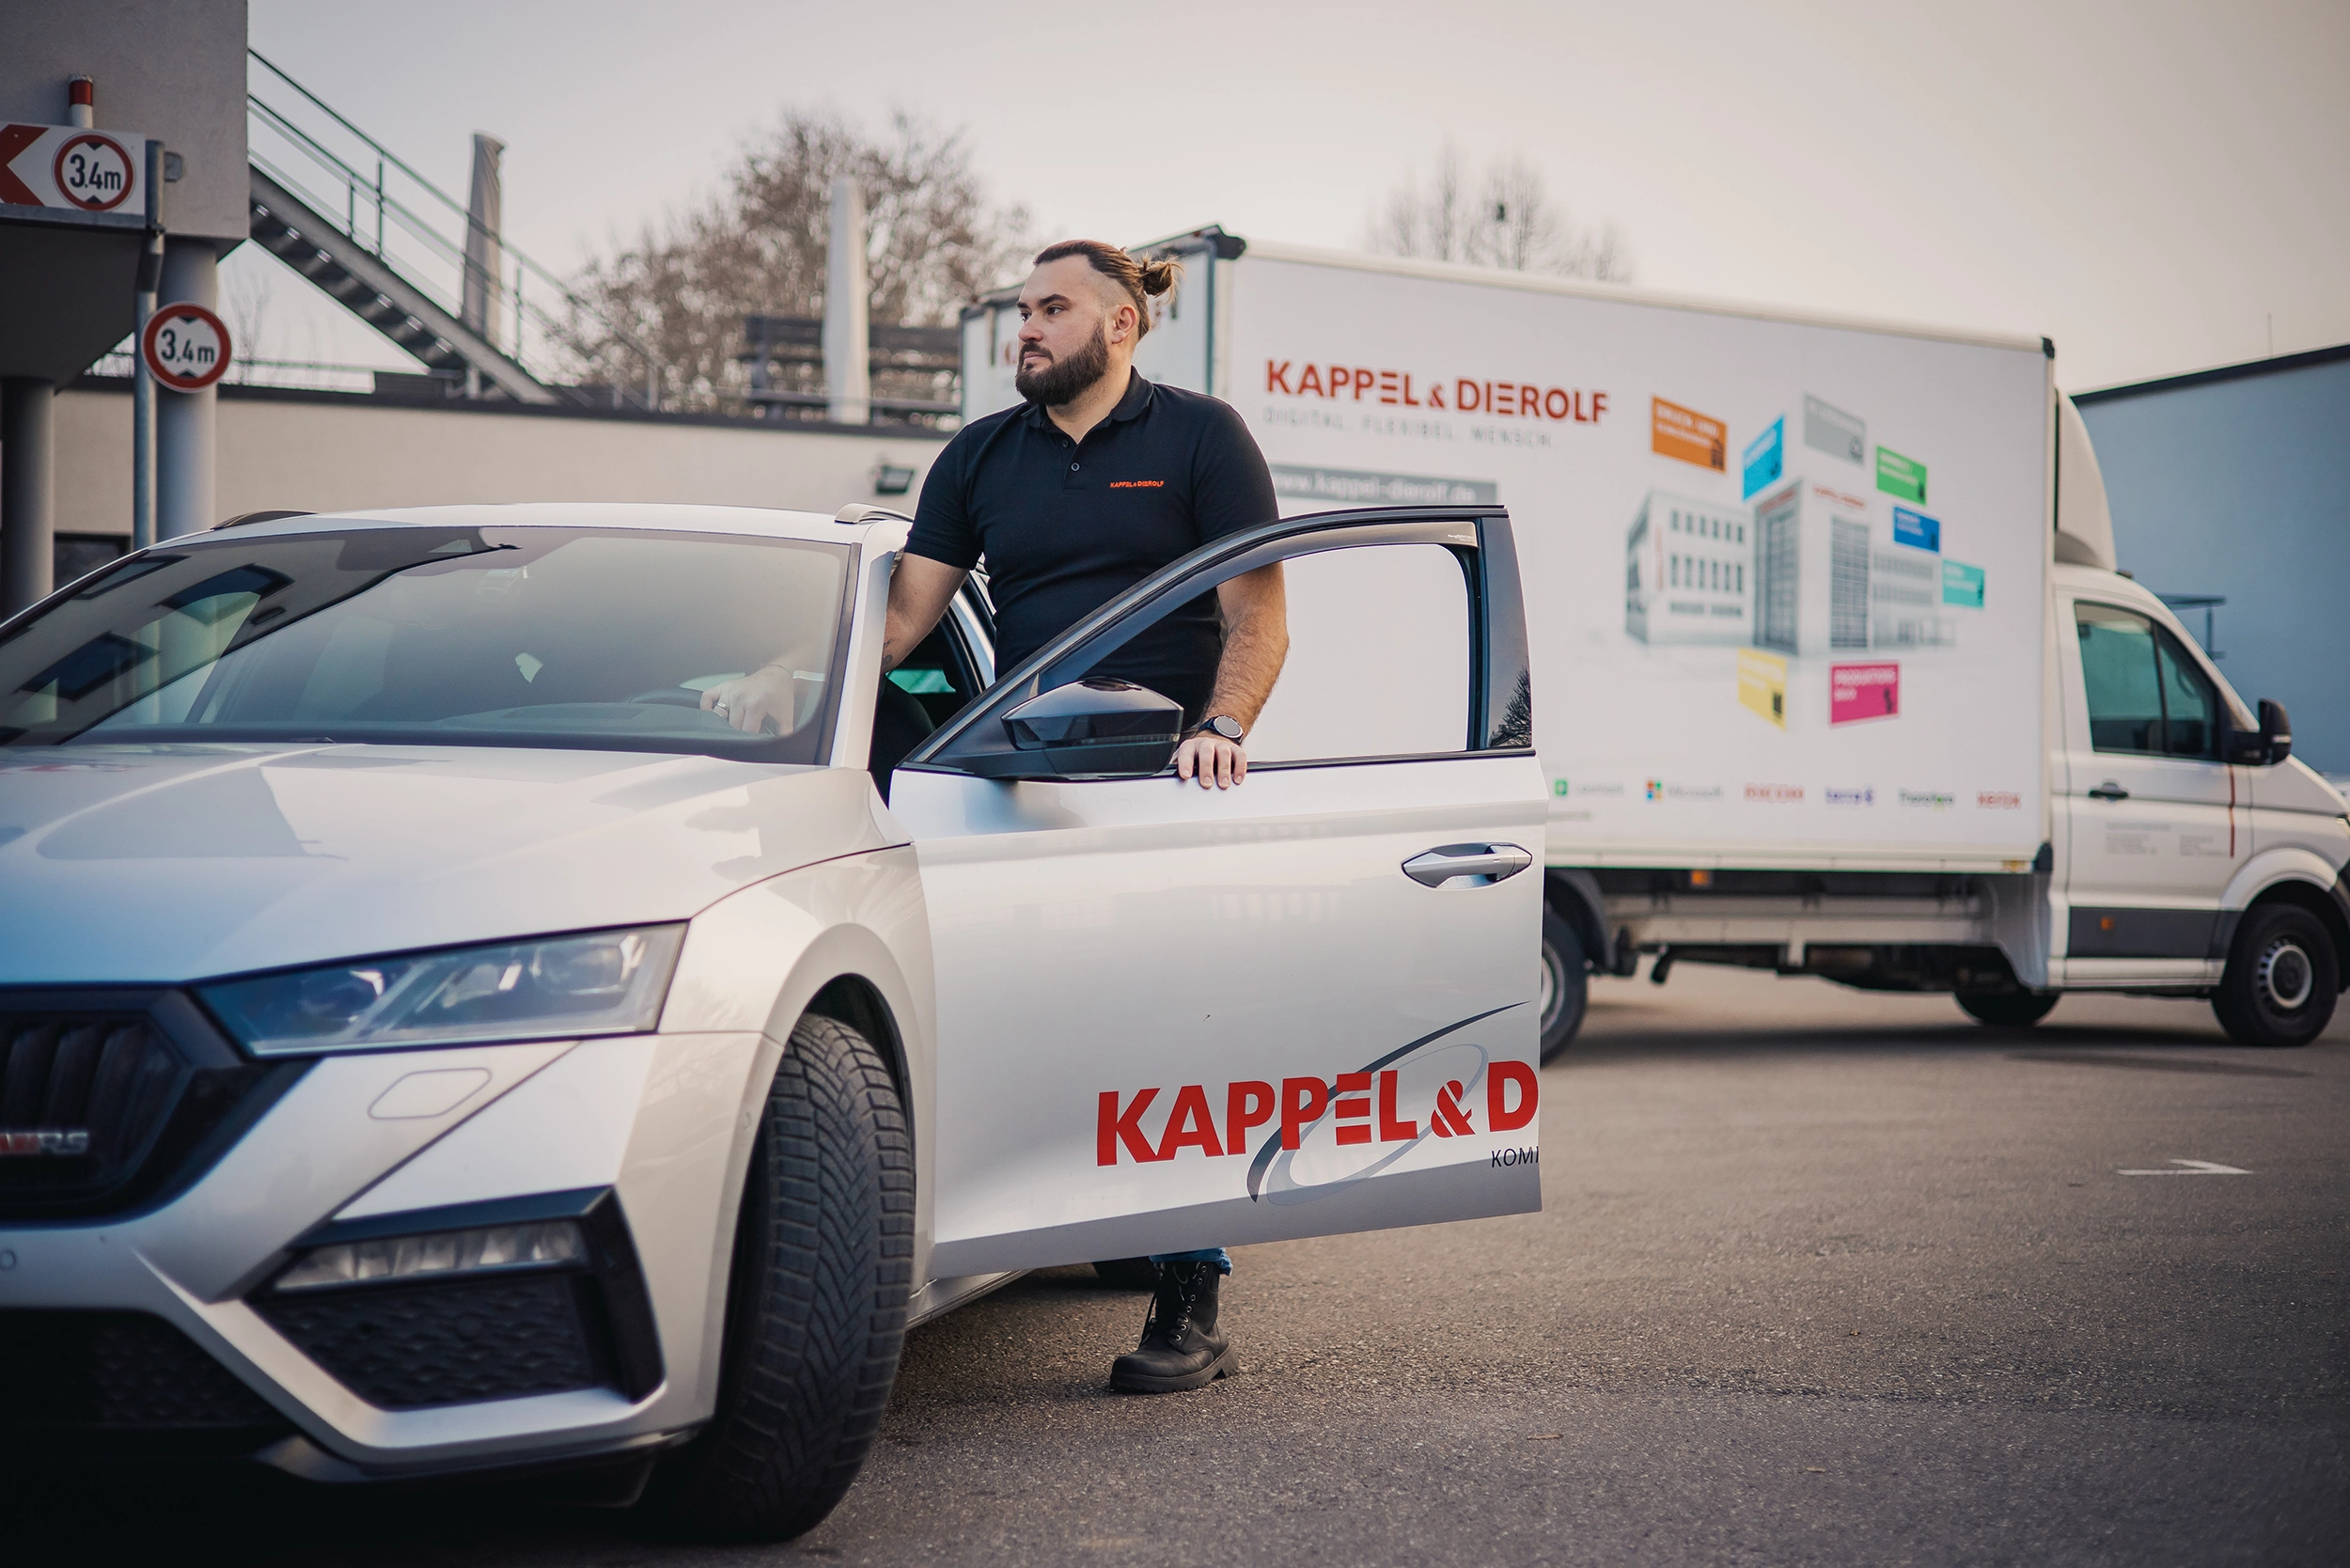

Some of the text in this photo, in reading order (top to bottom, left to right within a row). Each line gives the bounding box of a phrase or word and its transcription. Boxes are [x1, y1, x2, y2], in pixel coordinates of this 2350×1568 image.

[1266, 359, 1608, 423] KAPPEL & DIEROLF
[1096, 1059, 1539, 1167] KAPPEL & D
